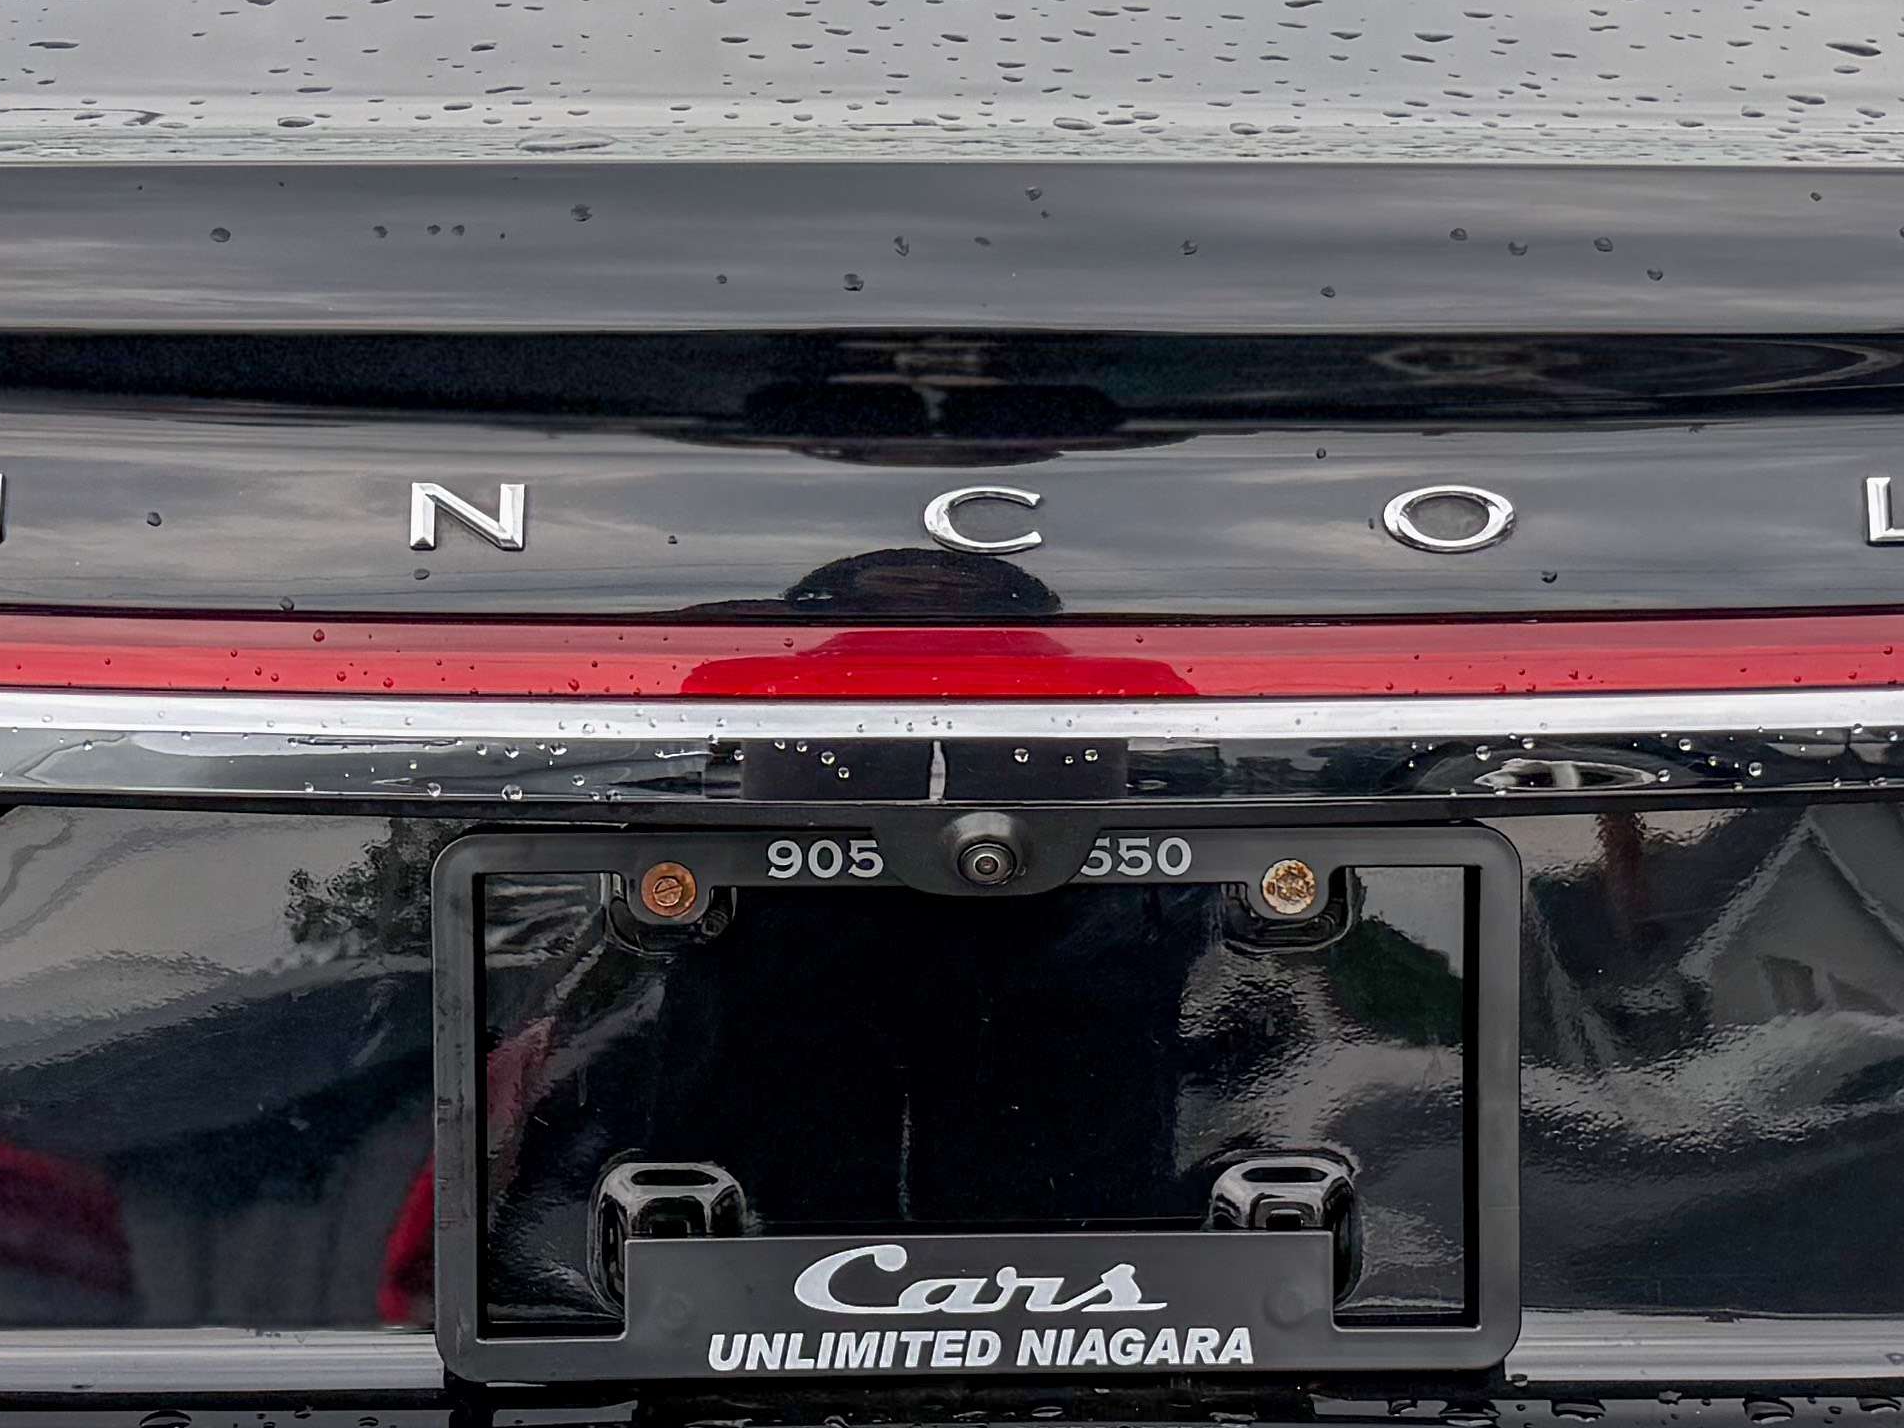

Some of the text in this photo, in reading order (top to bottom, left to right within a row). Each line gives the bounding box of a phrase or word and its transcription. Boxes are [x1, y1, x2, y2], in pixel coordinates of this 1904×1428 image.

[767, 839, 884, 879] 905
[794, 1244, 1168, 1314] Cars
[708, 1327, 1255, 1371] UNLIMITED NIAGARA
